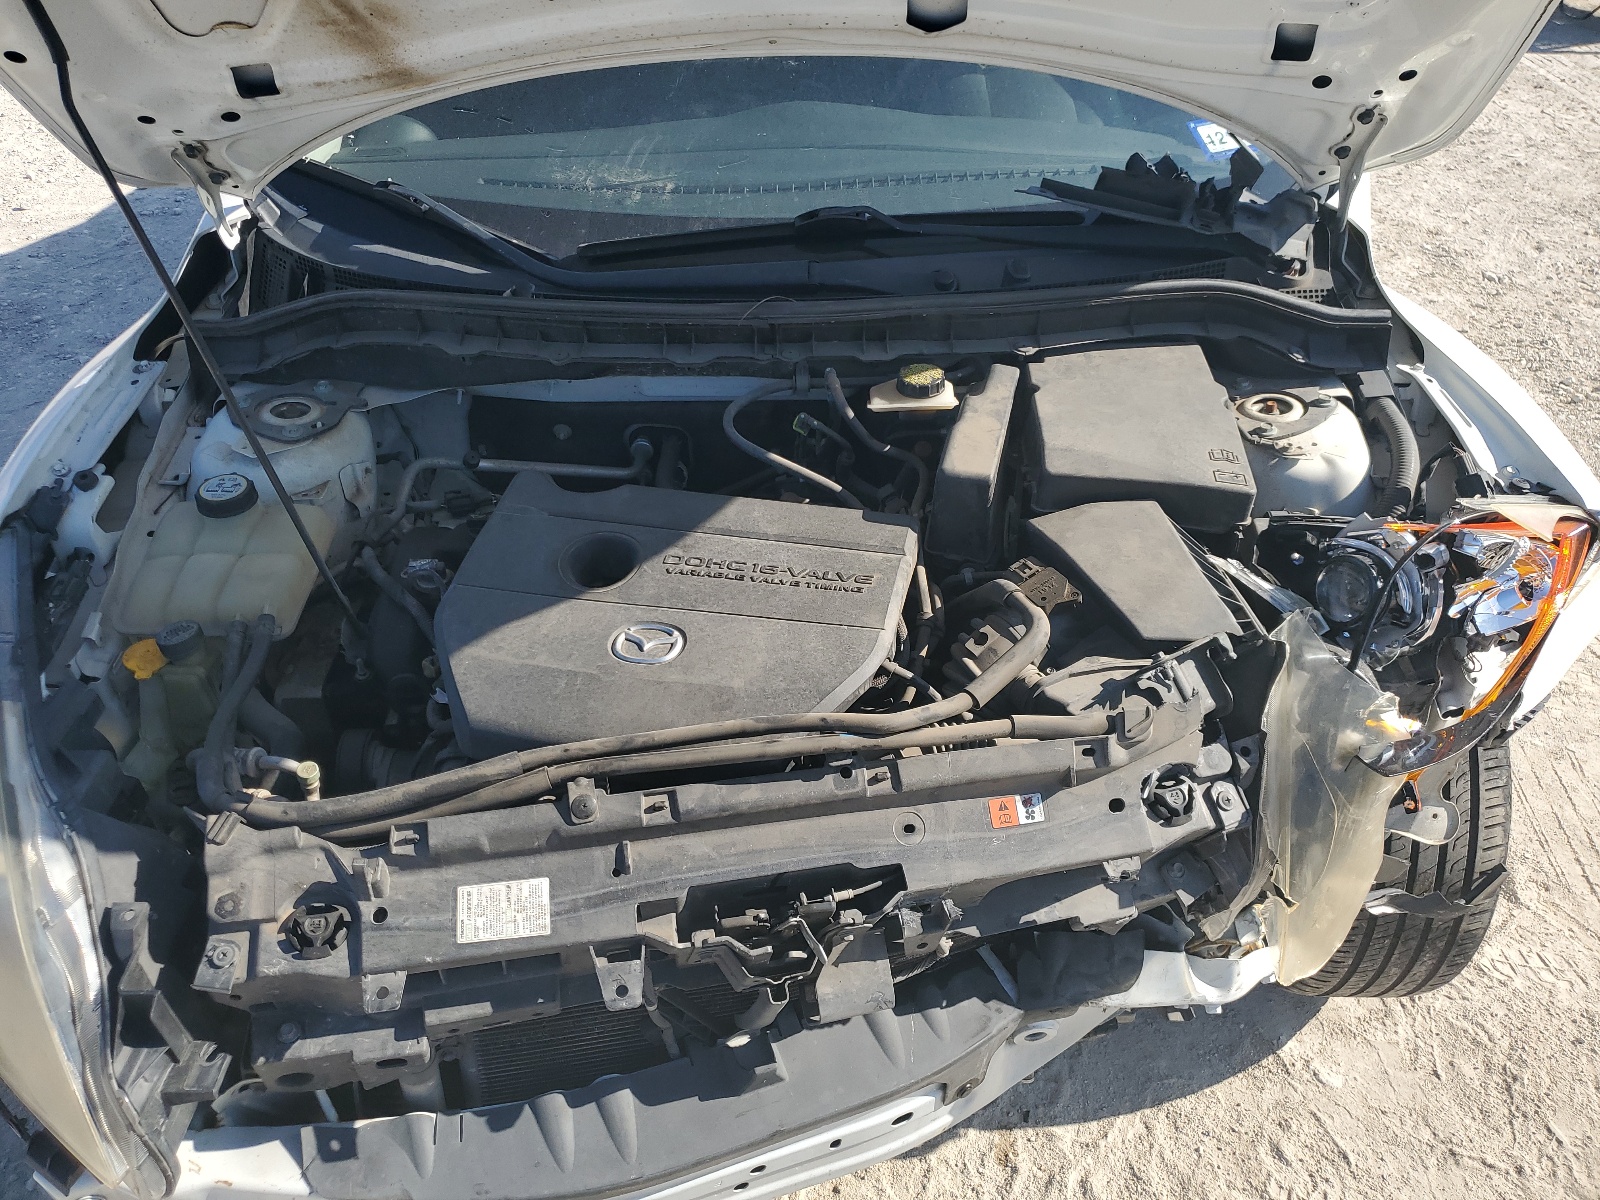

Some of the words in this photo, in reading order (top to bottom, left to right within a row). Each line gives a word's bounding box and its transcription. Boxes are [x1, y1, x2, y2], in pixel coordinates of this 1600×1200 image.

[662, 555, 747, 572] DOHC
[751, 563, 874, 585] 16-VALVE
[665, 567, 746, 581] VARIABLE
[750, 576, 801, 587] VALVE
[804, 582, 865, 593] TIMING
